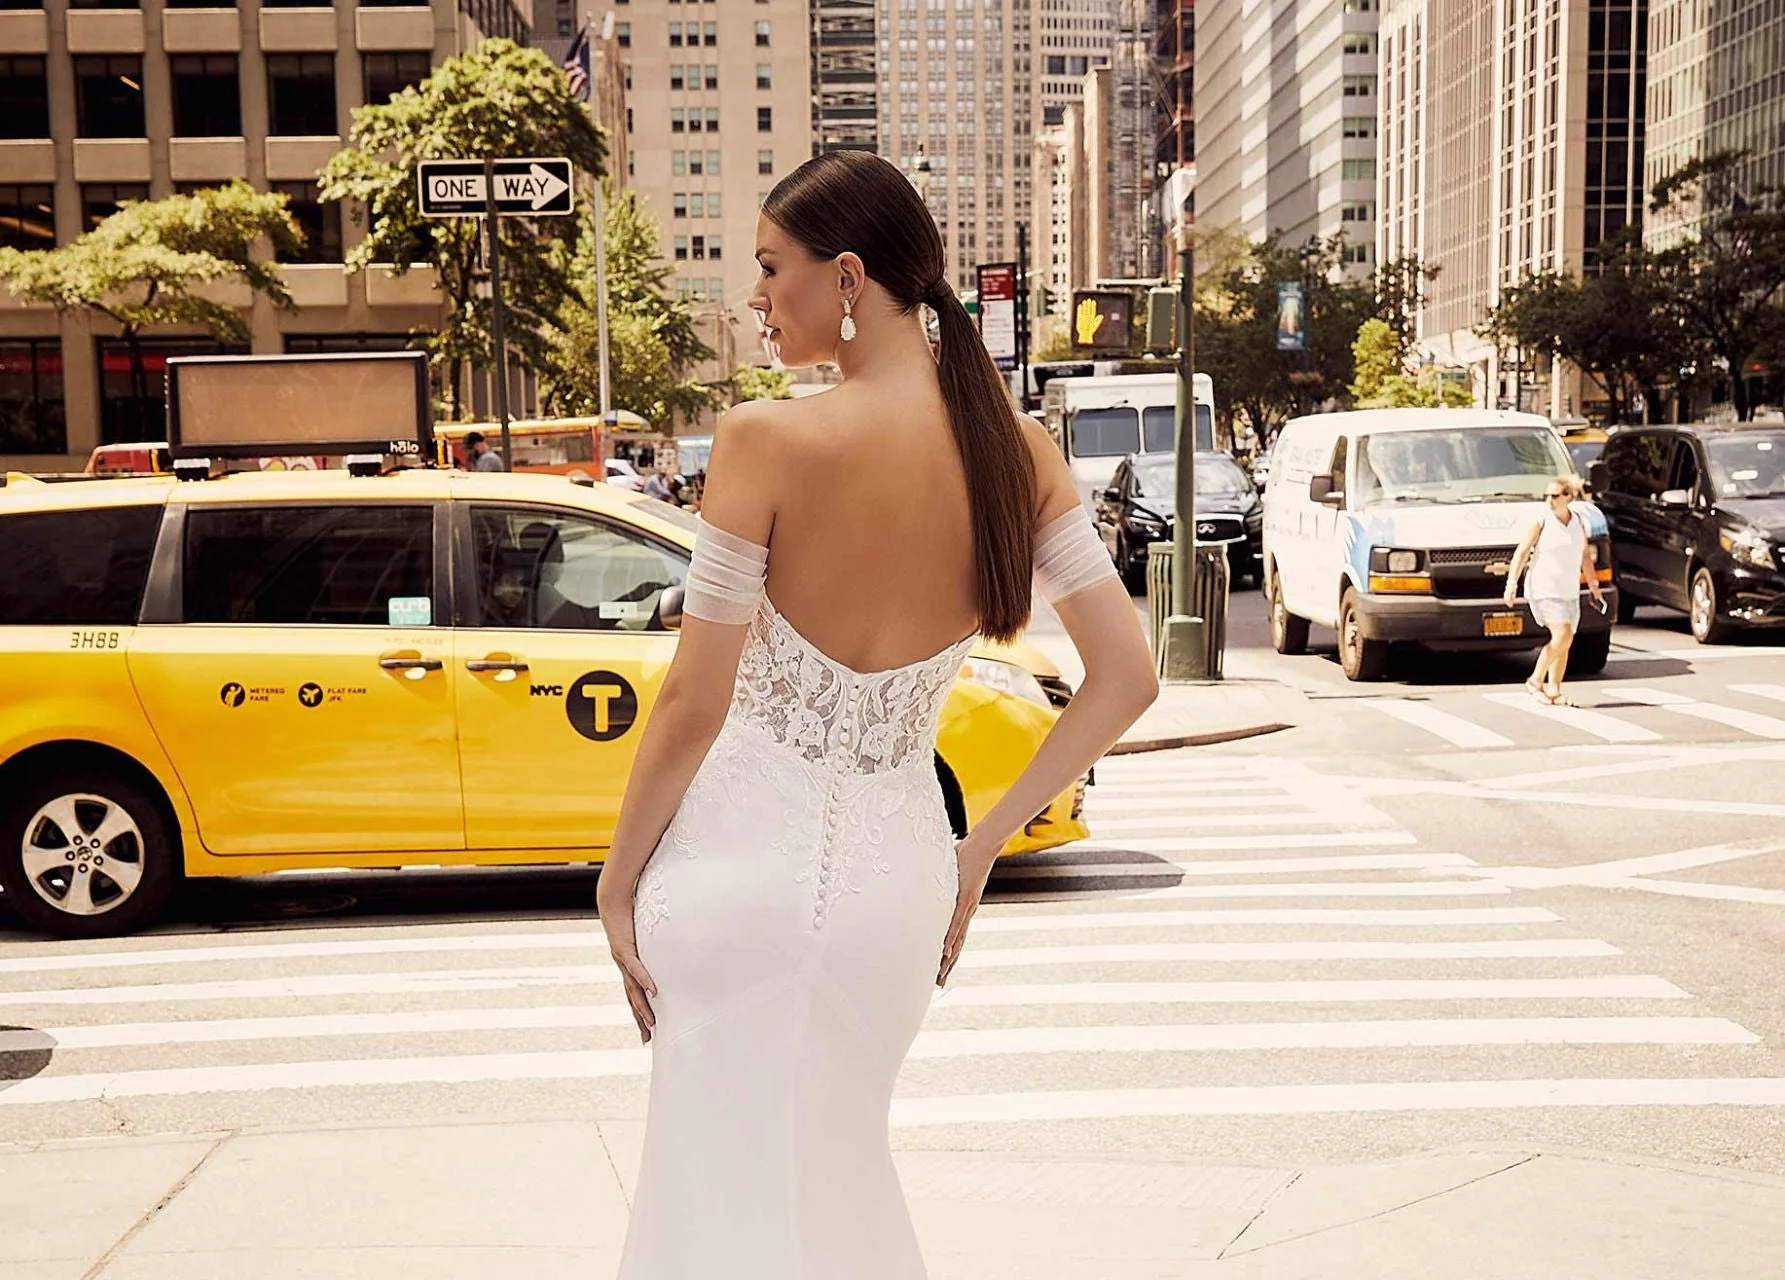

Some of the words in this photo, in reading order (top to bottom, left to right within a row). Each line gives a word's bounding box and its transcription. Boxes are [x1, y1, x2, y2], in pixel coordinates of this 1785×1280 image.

[435, 179, 477, 198] ONE
[503, 177, 549, 197] WAY
[530, 685, 563, 696] NYC
[582, 684, 622, 733] T
